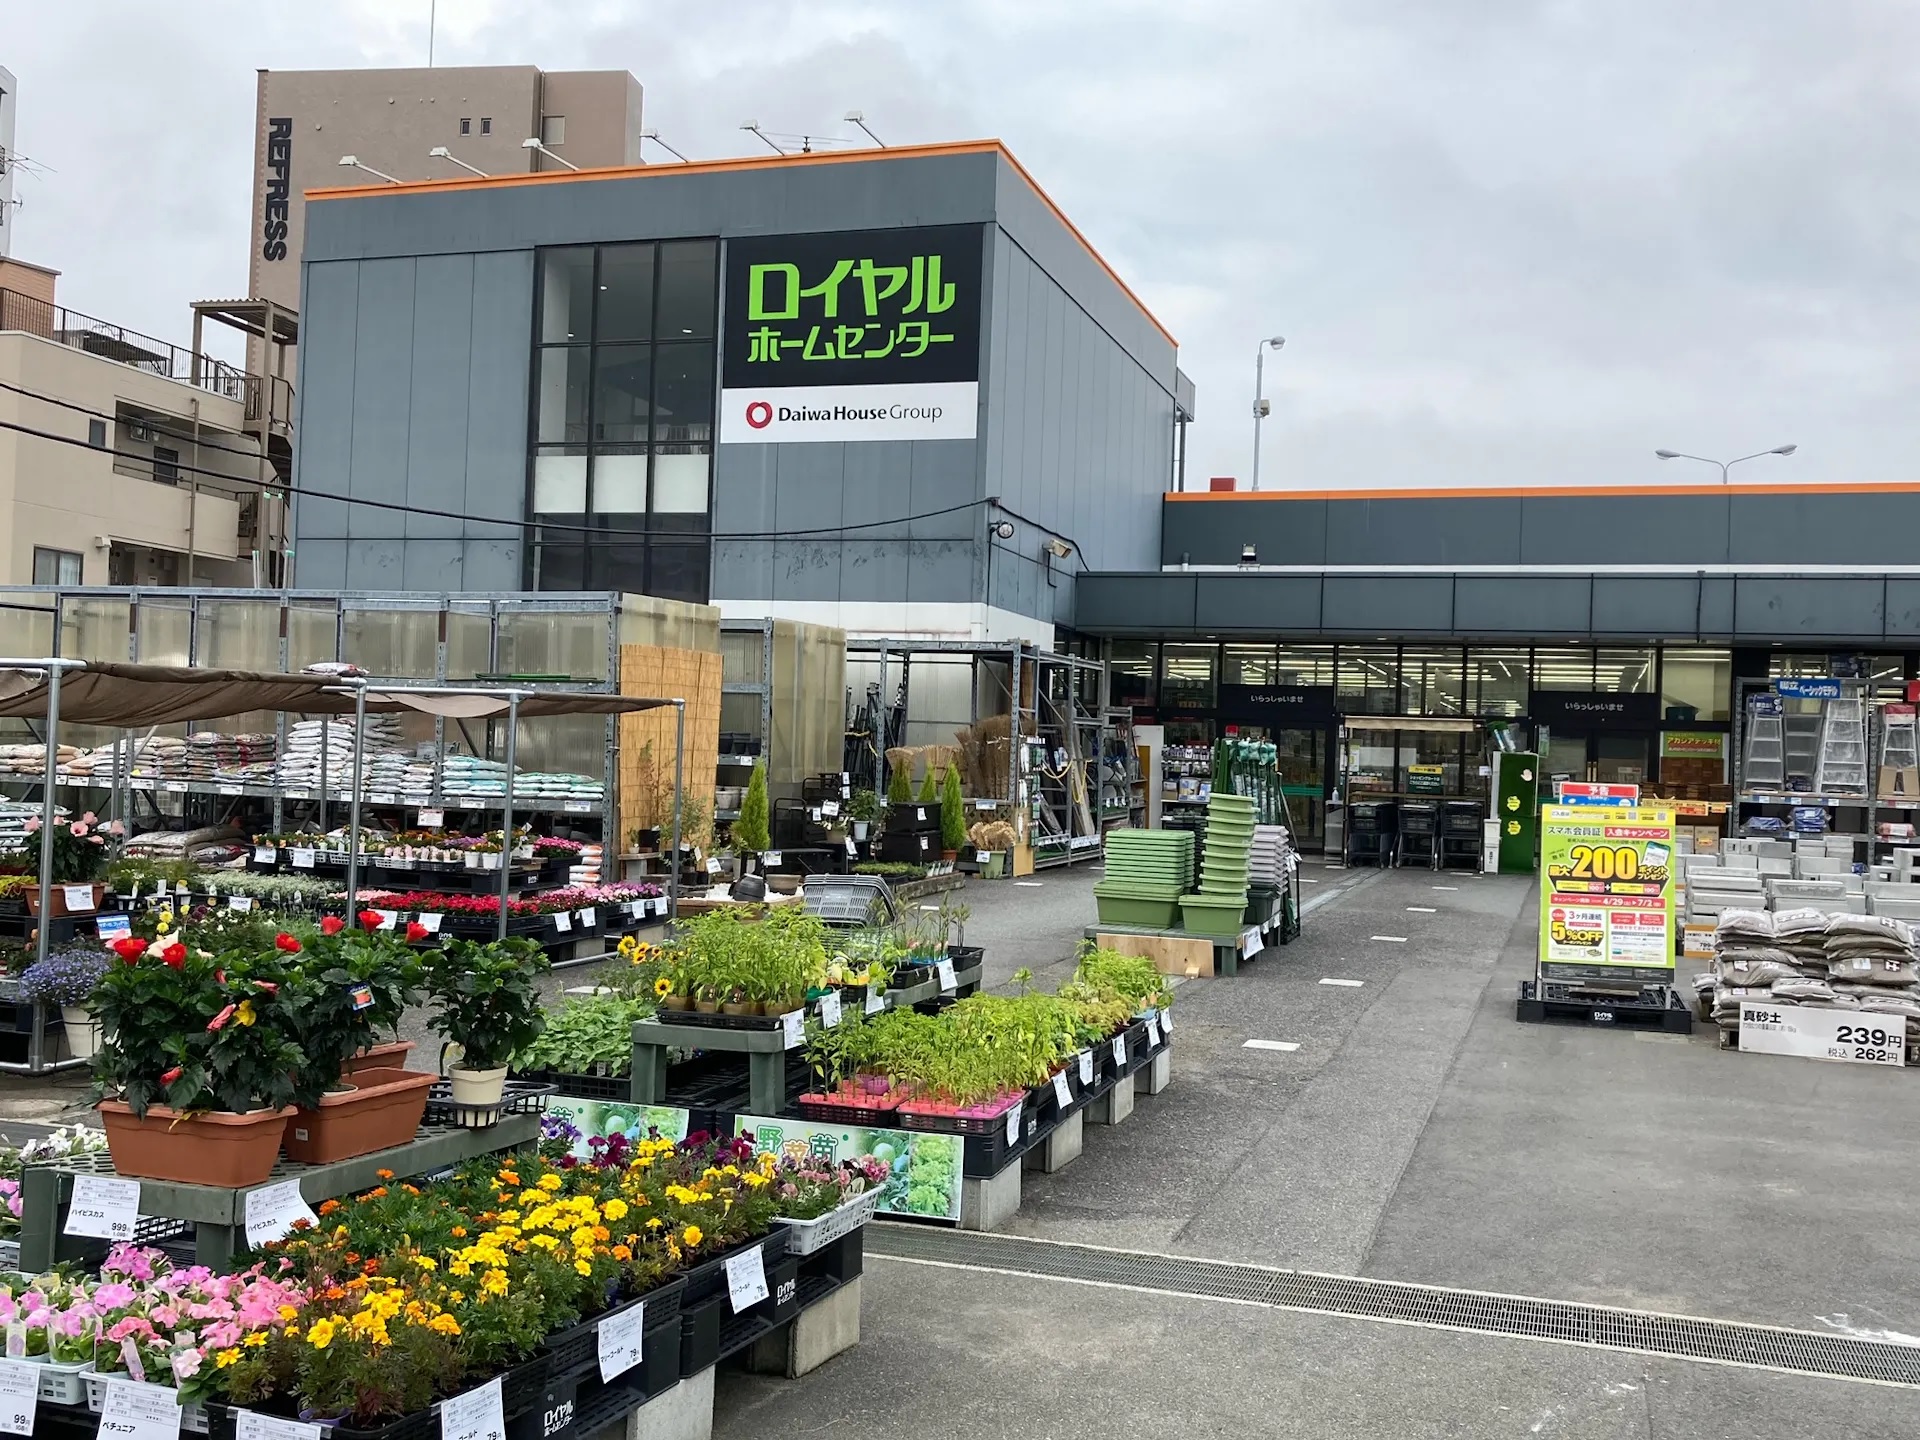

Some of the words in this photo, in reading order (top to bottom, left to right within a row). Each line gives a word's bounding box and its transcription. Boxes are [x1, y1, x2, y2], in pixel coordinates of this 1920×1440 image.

[263, 118, 292, 261] REFRESS
[748, 255, 956, 321] ロイヤル
[747, 321, 954, 362] ホームセンター
[778, 406, 831, 421] Daiwa
[834, 405, 887, 421] House
[889, 404, 943, 423] Group
[1250, 695, 1304, 703] いらっしゃいませ
[1565, 702, 1624, 711] いらっしゃいませ
[1548, 826, 1601, 837] スマホ会員証
[1606, 827, 1668, 838] 入会キャンペーン
[1548, 864, 1570, 877] 最大
[1570, 845, 1639, 880] 200
[1603, 897, 1624, 906] 4/29
[1637, 899, 1653, 907] 7/2
[1551, 920, 1604, 941] 5%OFF
[1743, 1010, 1782, 1024] 真砂土
[1836, 1025, 1903, 1048] 239円
[1828, 1047, 1848, 1058] 税込
[1855, 1047, 1899, 1062] 262円
[71, 1209, 105, 1218] ハイビスカス
[247, 1218, 278, 1232] ハイビスカス
[544, 1400, 574, 1427] ロイヤル
[102, 1421, 136, 1434] ペチュニア
